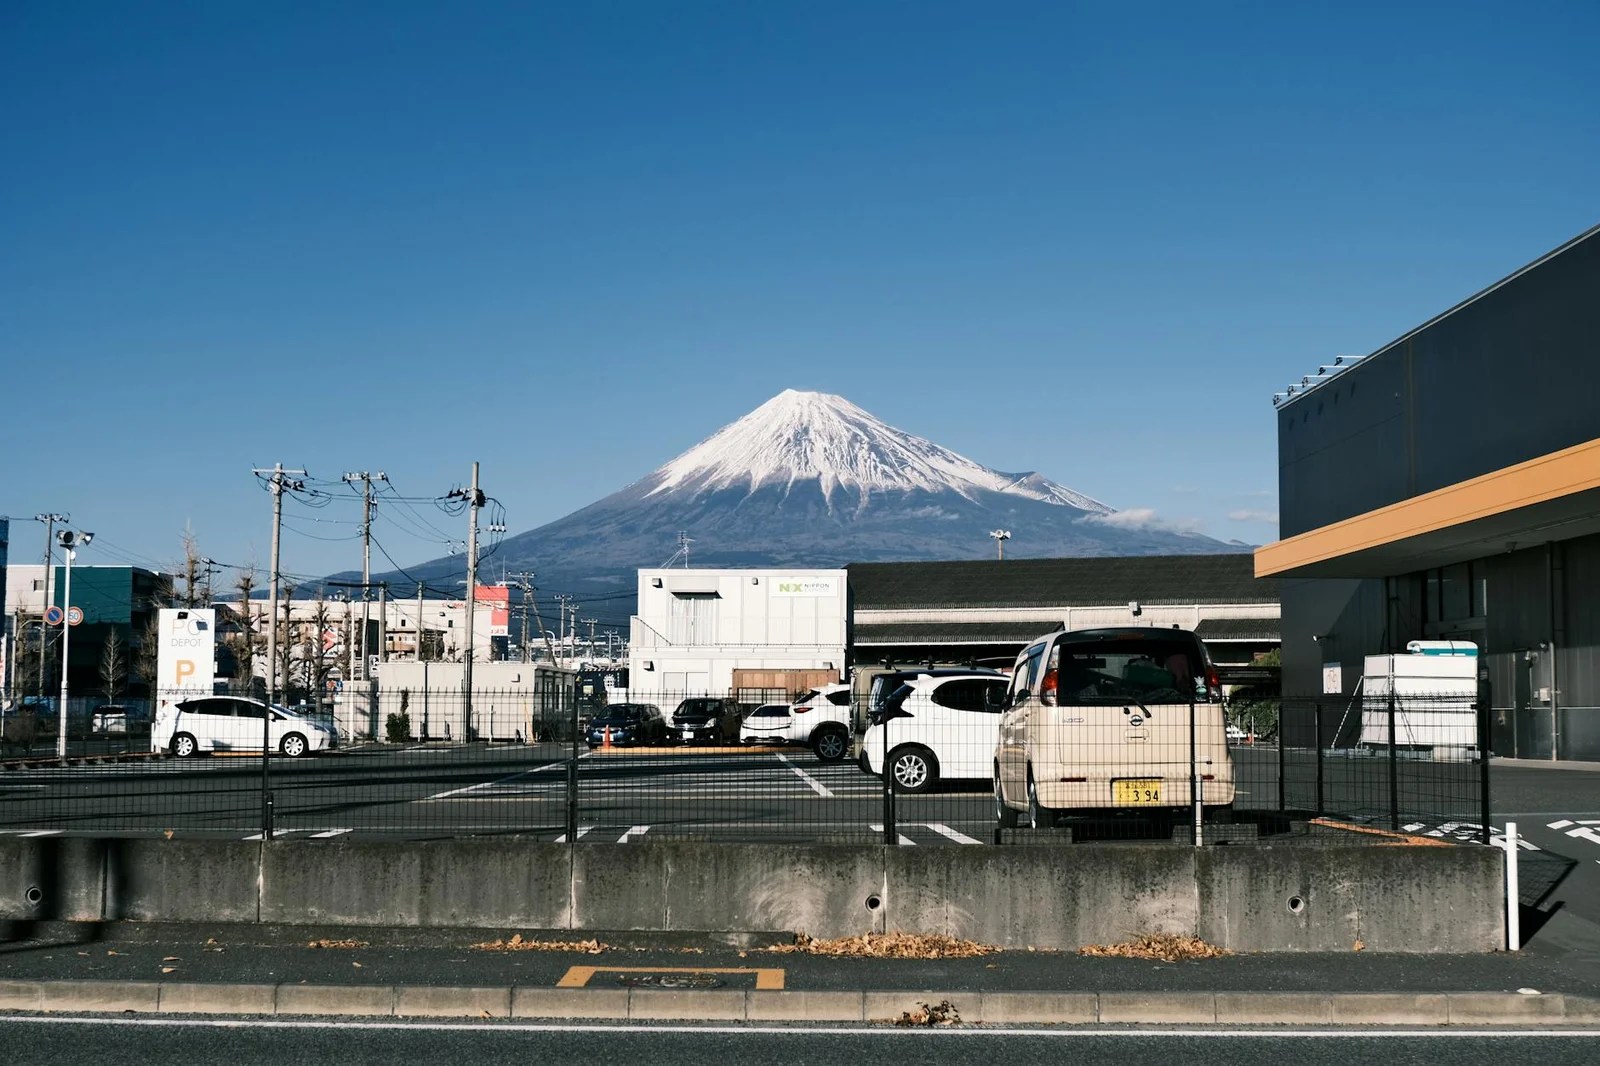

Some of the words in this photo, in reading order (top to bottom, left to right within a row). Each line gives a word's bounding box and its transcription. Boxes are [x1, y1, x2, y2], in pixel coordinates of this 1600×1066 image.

[779, 583, 802, 592] NX
[69, 612, 79, 620] 50
[171, 638, 202, 647] DEPOT
[176, 659, 195, 685] P
